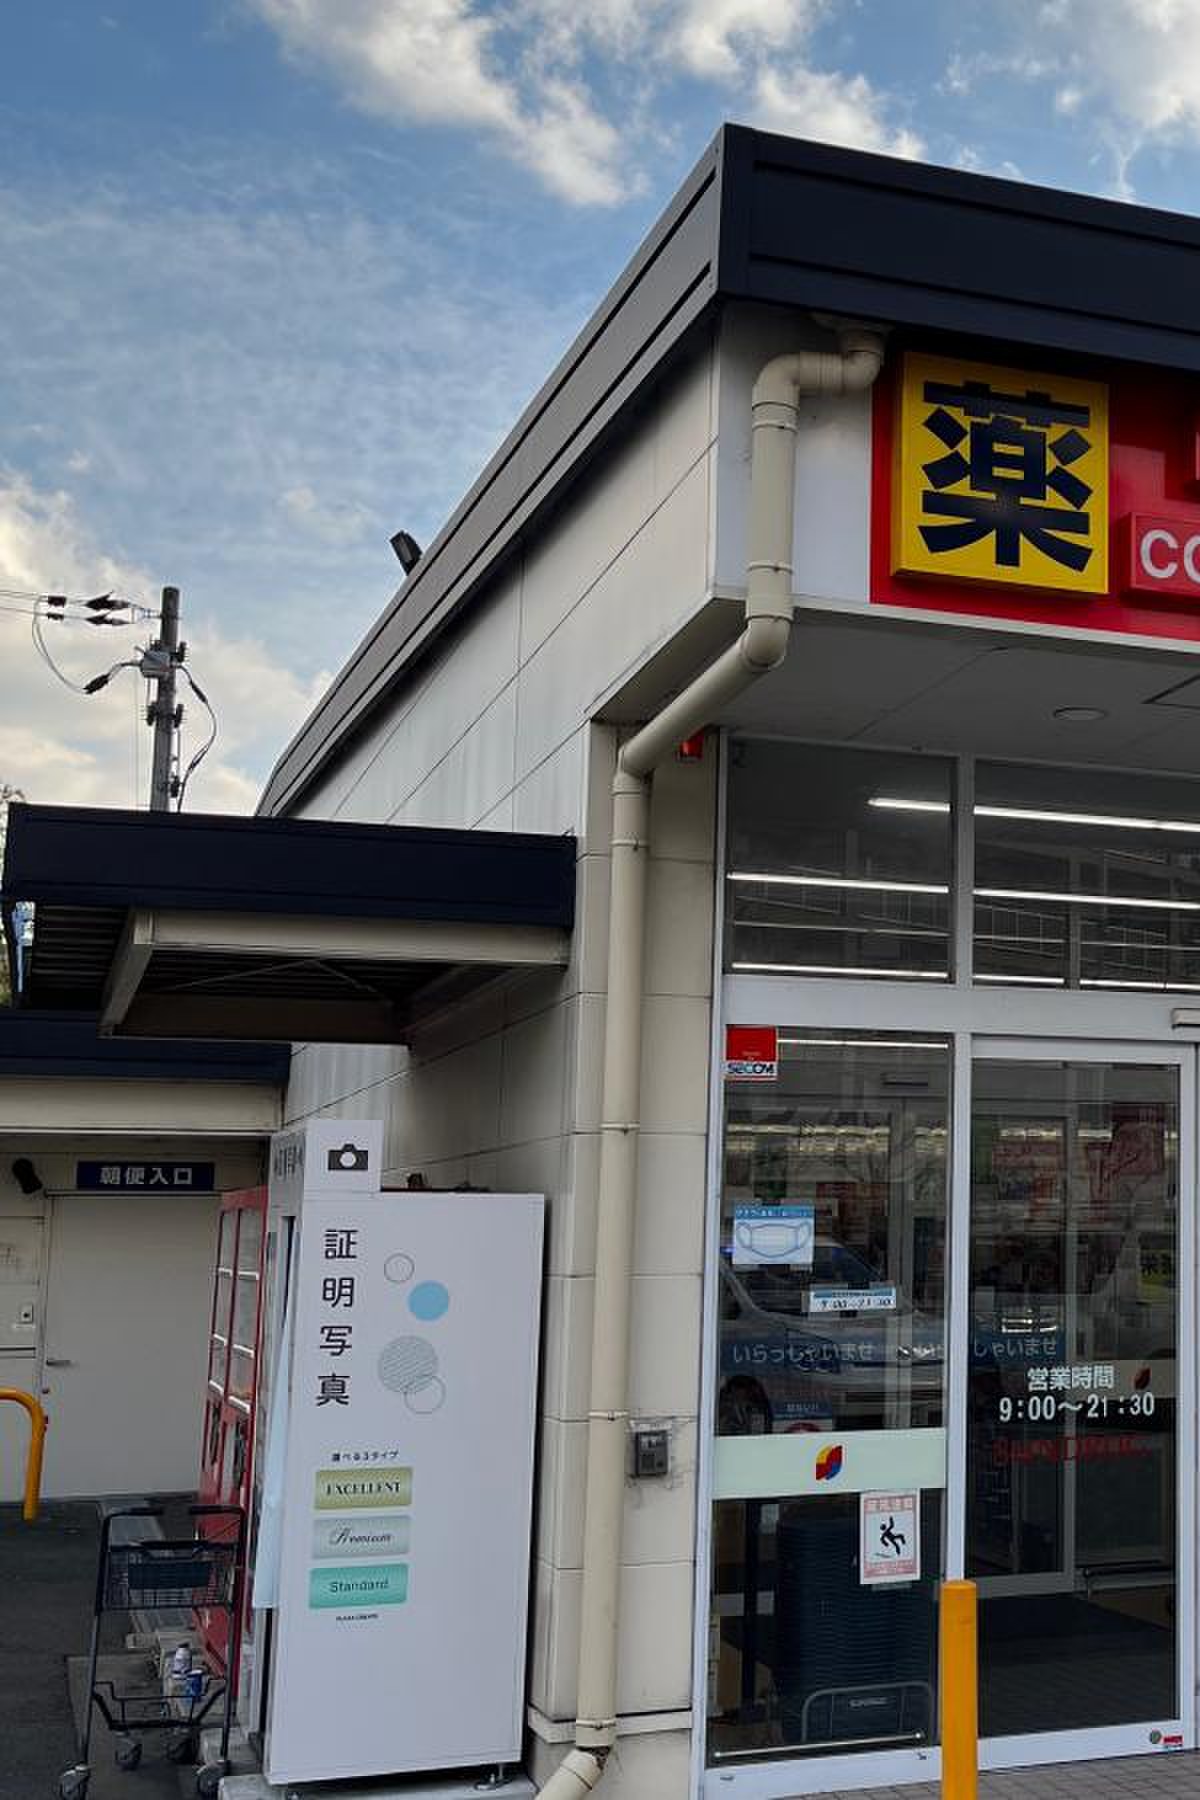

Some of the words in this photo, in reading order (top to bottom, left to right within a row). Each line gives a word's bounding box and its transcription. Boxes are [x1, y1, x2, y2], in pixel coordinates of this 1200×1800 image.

[918, 380, 1093, 572] 薬
[316, 1227, 358, 1407] 証明写真
[1027, 1365, 1115, 1392] 営業時間
[326, 1481, 401, 1495] EXCELLENT
[330, 1577, 389, 1594] Standard
